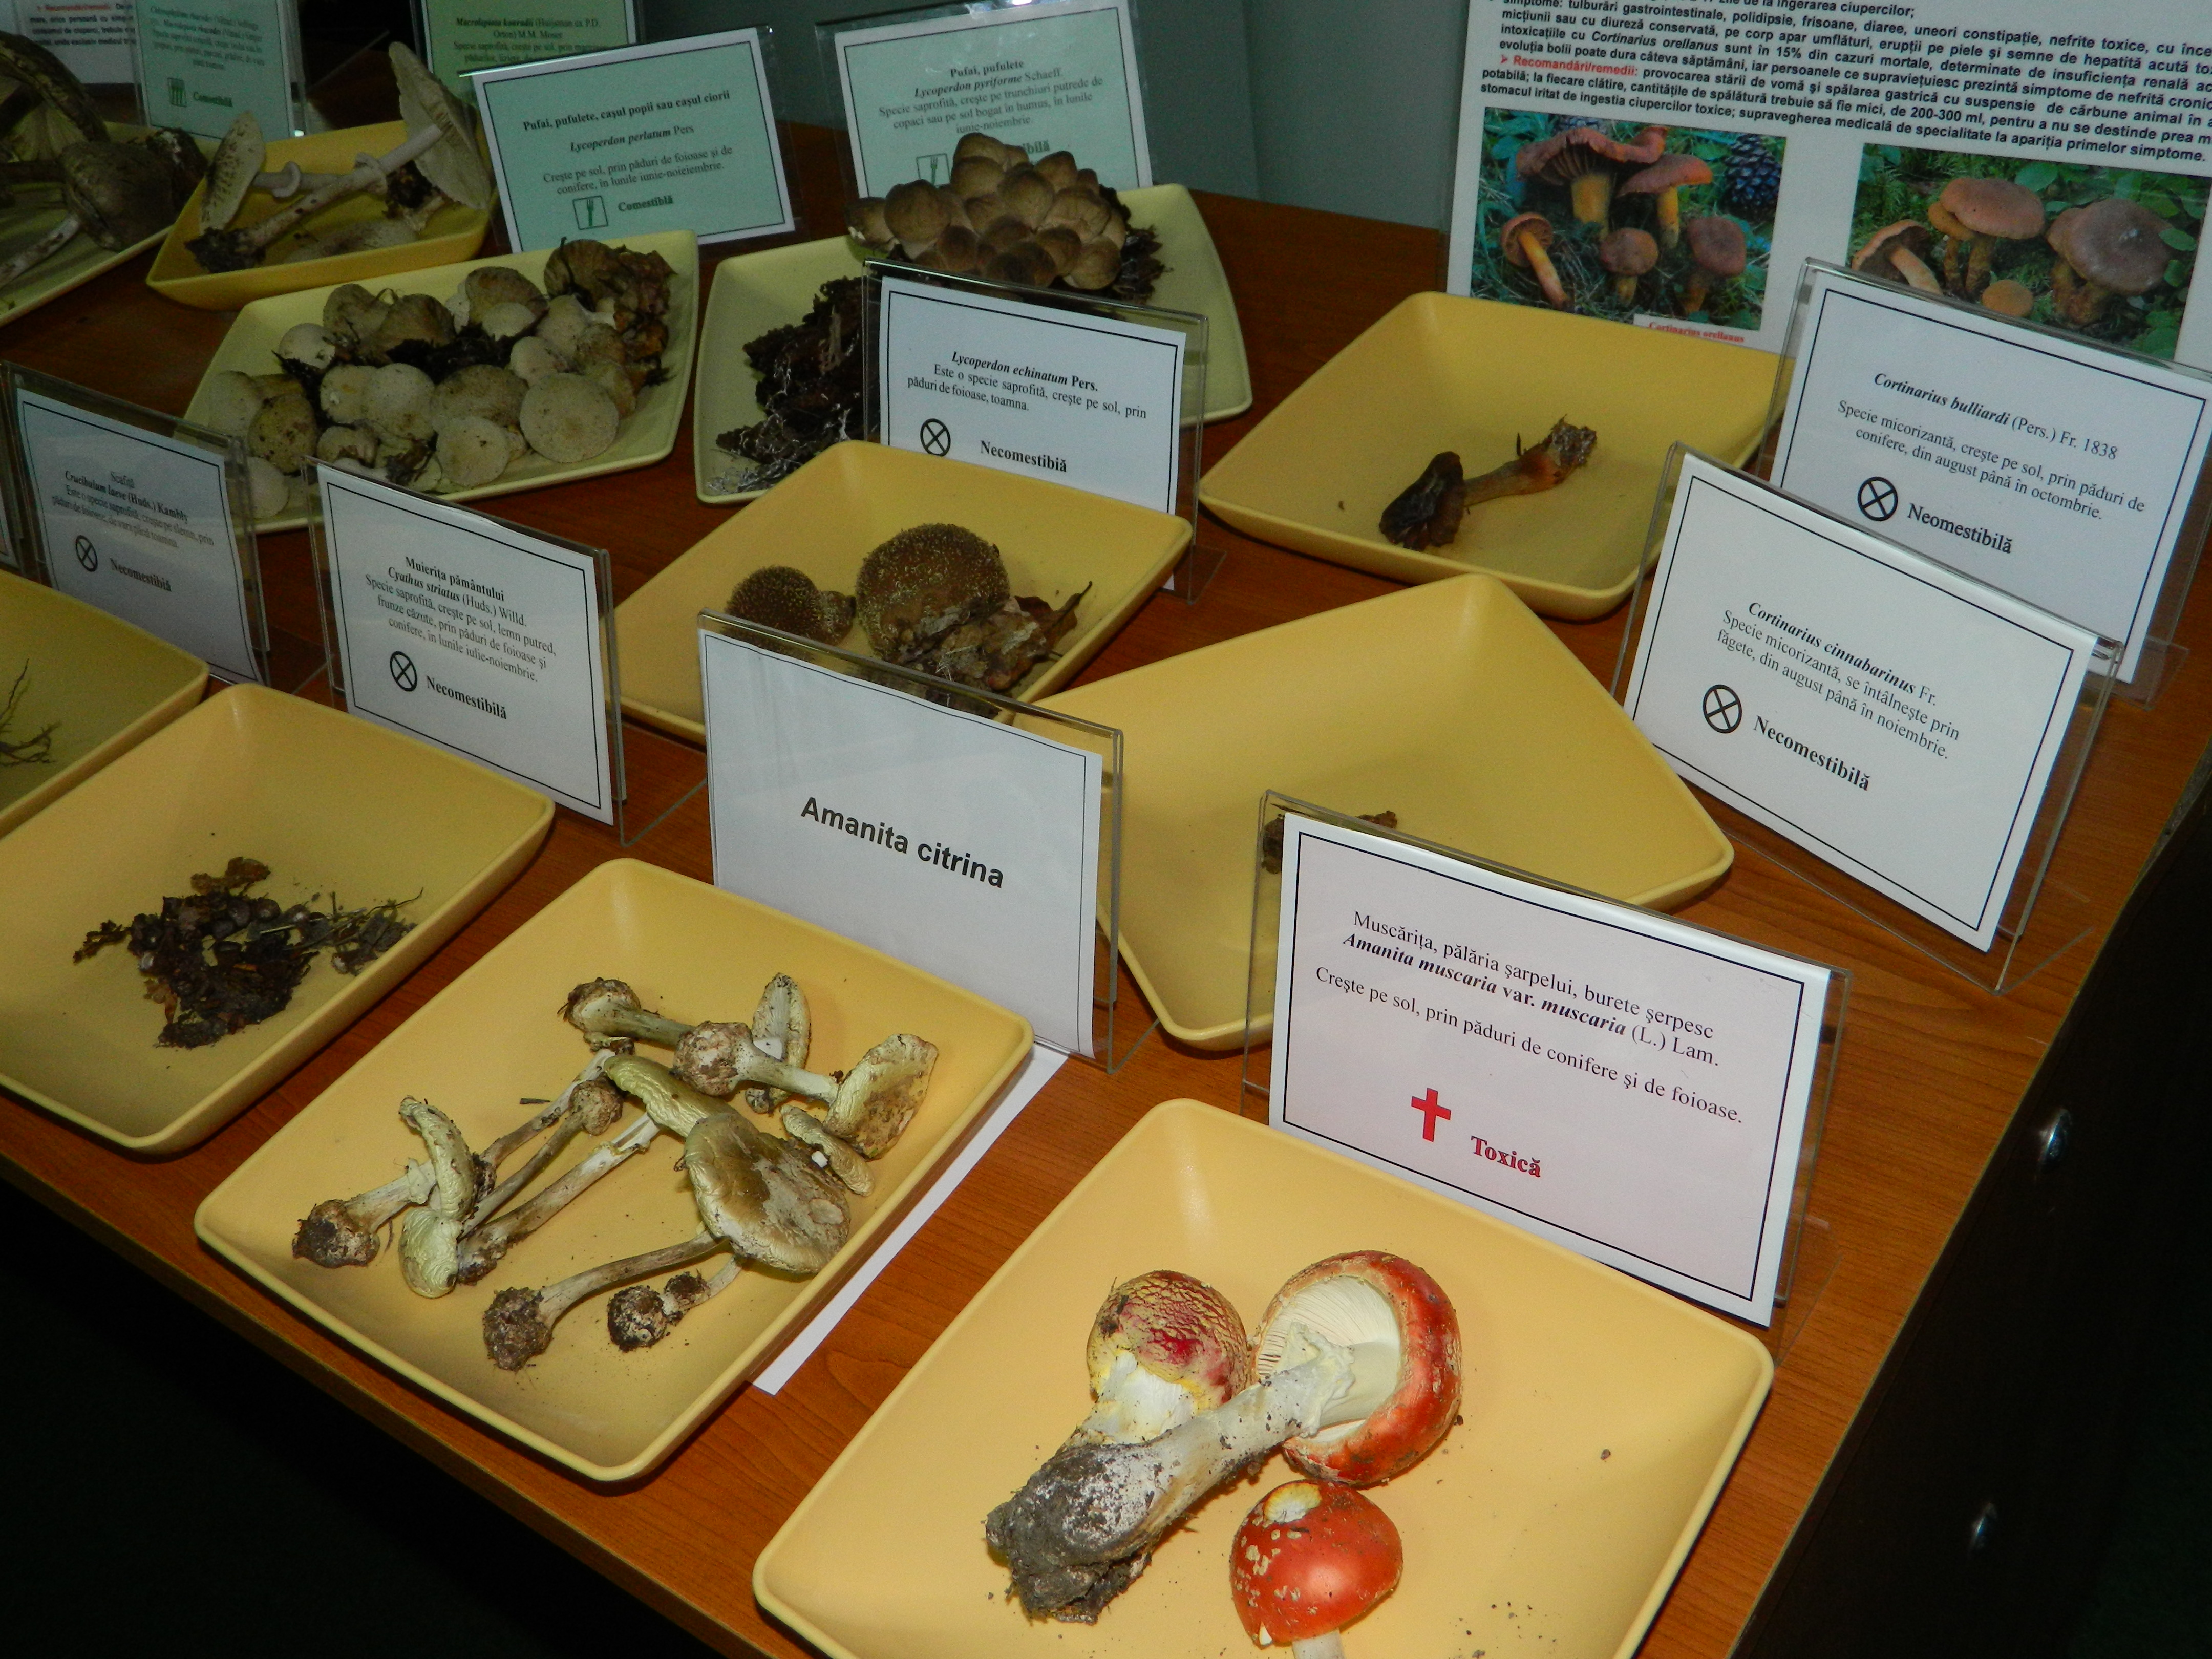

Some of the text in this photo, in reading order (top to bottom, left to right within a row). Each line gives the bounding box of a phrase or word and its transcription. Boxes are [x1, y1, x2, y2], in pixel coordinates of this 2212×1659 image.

[1481, 83, 1532, 96] stomacul
[1535, 88, 1560, 99] iritat
[1563, 90, 1577, 101] de
[1580, 92, 1625, 105] ingestia
[1629, 97, 1692, 112] ciupercilor
[1695, 103, 1735, 118] toxice;
[1739, 109, 1831, 126] supravegherea
[1896, 122, 1912, 134] de
[1916, 126, 1992, 141] specialitate
[1995, 131, 2007, 142] la
[2066, 139, 2127, 154] primelor
[2130, 144, 2205, 162] simptome.
[1643, 69, 1710, 82] provocarea
[1750, 76, 1766, 88] de
[1943, 95, 1960, 105] cu
[1965, 97, 2036, 112] suspensie
[2047, 102, 2064, 114] de
[2133, 111, 2183, 124] animal
[907, 376, 1029, 411] păduri de foioase, toamna.
[934, 364, 954, 378] Este
[968, 374, 998, 388] specie
[1002, 381, 1048, 399] saprofită,
[1086, 399, 1099, 410] pe
[1102, 401, 1120, 415] sol,
[1125, 407, 1146, 419] prin
[951, 351, 1098, 392] Lycoperdon echinatum Pers.
[1839, 400, 1878, 423] Specie
[1881, 417, 1956, 452] micorizantă,
[2001, 457, 2018, 470] pe
[2021, 464, 2044, 480] sol,
[2047, 473, 2076, 490] prin
[2078, 483, 2124, 505] păduri
[2128, 496, 2145, 512] de
[1874, 373, 2118, 459] Cortinarius bulliardi (Pers.) Fr. 1838
[1856, 429, 2101, 520] conifere, din august până în octombrie.
[365, 574, 393, 594] Specie
[466, 614, 477, 626] pe
[479, 620, 496, 633] sol,
[498, 623, 521, 642] lemn
[523, 636, 556, 656] putred,
[377, 595, 405, 614] frunze
[438, 621, 457, 634] prin
[490, 638, 500, 651] de
[503, 642, 536, 665] foioase
[388, 566, 424, 589] Cyathus
[426, 583, 460, 602] striatus
[498, 606, 527, 627] Willd.
[389, 618, 426, 640] conifere,
[439, 634, 463, 653] lunile
[466, 648, 538, 682] iulie-noiembrie.
[1722, 610, 1762, 641] Specie
[1766, 635, 1841, 683] micorizantă,
[1847, 676, 1860, 690] se
[1929, 719, 1959, 740] prin
[1749, 602, 1936, 706] Cortinarius cinnabarinus Fr.
[1717, 630, 1948, 759] făgete, din august până în noiembrie.
[1754, 715, 1870, 791] Necomestibilă
[800, 797, 1004, 889] Amanita citrina
[1343, 933, 1718, 1066] Amanita muscaria var. muscaria (L.) Lam.
[1354, 911, 1437, 953] Muscărița,
[1443, 944, 1499, 972] pălăria
[1585, 984, 1640, 1015] burete
[1369, 988, 1388, 1003] pe
[1393, 996, 1420, 1016] sol,
[1426, 1007, 1458, 1027] prin
[1463, 1020, 1516, 1047] păduri
[1521, 1037, 1541, 1055] de
[1547, 1049, 1618, 1081] conifere
[1644, 1078, 1665, 1097] de
[1672, 1087, 1742, 1123] foioase.
[1471, 1135, 1541, 1178] Toxică
